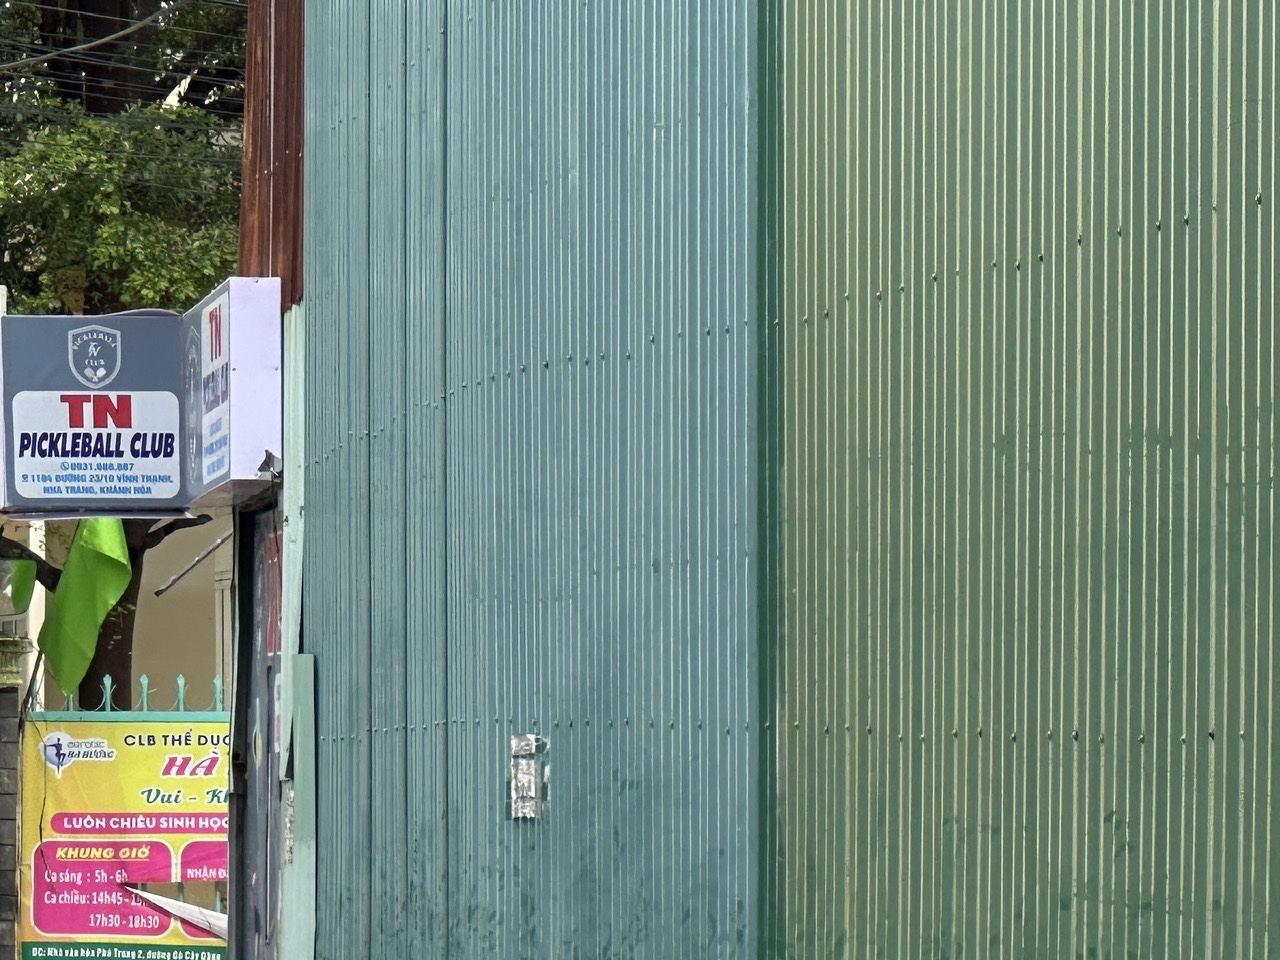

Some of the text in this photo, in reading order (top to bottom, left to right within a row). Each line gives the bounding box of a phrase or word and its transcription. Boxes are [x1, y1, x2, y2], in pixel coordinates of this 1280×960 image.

[60, 394, 132, 429] TN
[19, 432, 124, 458] PICKLEBALL
[130, 432, 175, 458] CLUB
[43, 486, 62, 494] NHA
[124, 735, 156, 746] CLB
[162, 728, 192, 746] THỂ
[162, 751, 219, 776] HÀ
[141, 788, 182, 804] Vui
[63, 815, 106, 829] LUÔN
[109, 815, 156, 829] CHIÊU
[160, 817, 195, 829] SINH
[56, 844, 151, 859] KHUNG GIỜ
[44, 870, 57, 883] Ca
[60, 869, 82, 885] sáng
[95, 869, 107, 882] 5h
[44, 891, 57, 904] Ca
[92, 891, 123, 905] 14h45
[89, 913, 120, 927] 17h30
[128, 915, 159, 928] 18h30
[184, 951, 199, 960] Cây
